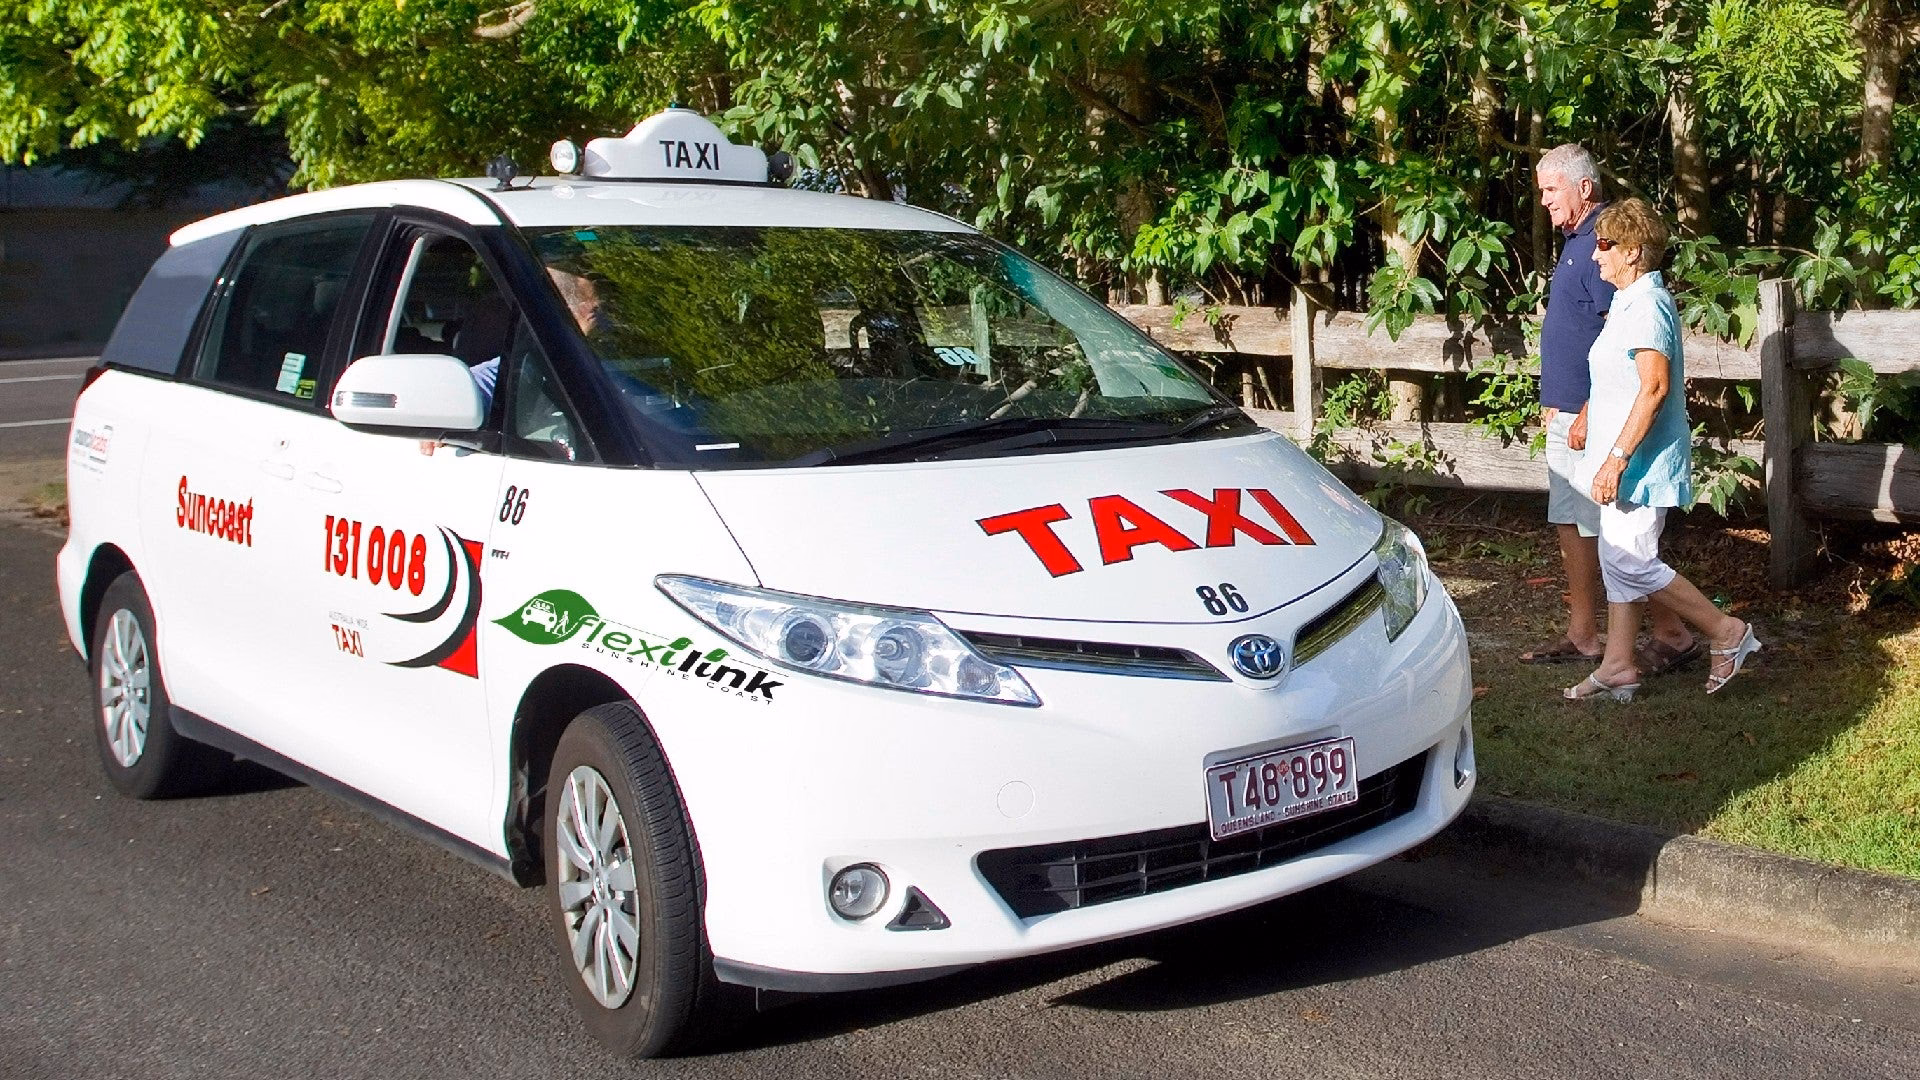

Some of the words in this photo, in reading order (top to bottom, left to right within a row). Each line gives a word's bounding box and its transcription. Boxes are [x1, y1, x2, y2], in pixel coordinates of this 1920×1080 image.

[659, 140, 720, 170] TAXI
[176, 475, 253, 547] Suncoast
[499, 485, 529, 525] 86
[975, 488, 1317, 578] TAXI
[325, 515, 362, 580] 131
[367, 526, 426, 596] 008
[1196, 582, 1249, 616] 86
[331, 624, 364, 658] TAXI
[581, 642, 690, 680] SUNSHINE
[706, 681, 772, 705] COAST
[1220, 811, 1275, 833] QUEENSLAND
[1283, 799, 1324, 817] SUNSHINE
[1326, 791, 1352, 806] STATE
